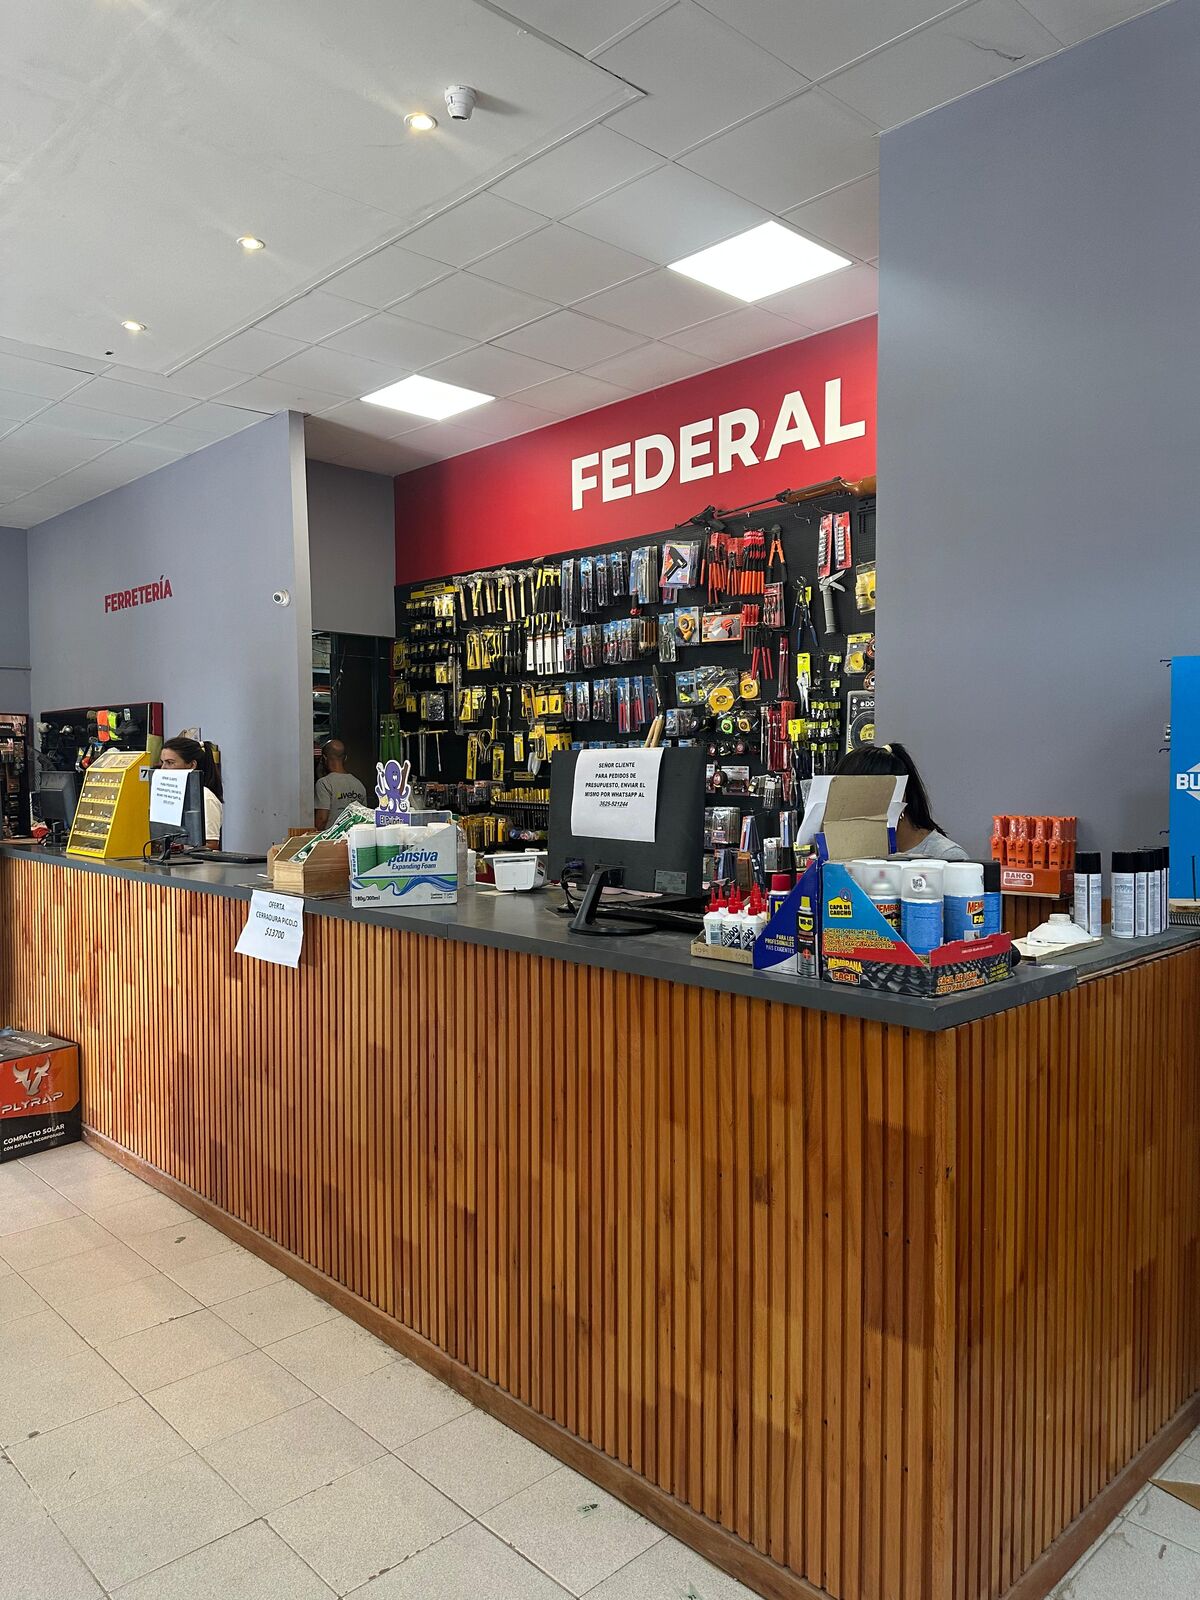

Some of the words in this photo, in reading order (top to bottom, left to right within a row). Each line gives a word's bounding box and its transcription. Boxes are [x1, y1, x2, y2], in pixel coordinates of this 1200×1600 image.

[571, 377, 866, 511] FEDERAL
[104, 574, 173, 613] FERRETERÍA
[391, 863, 420, 871] Expanding
[1005, 872, 1032, 880] BAHCO
[268, 900, 285, 910] OFERTA
[255, 910, 282, 923] CERRADURA
[281, 916, 298, 927] PICOLO
[827, 957, 863, 974] MEMBRANA
[1, 1091, 63, 1114] PLYRAP
[3, 1130, 42, 1145] COMPACTO
[42, 1123, 65, 1135] SOLAR
